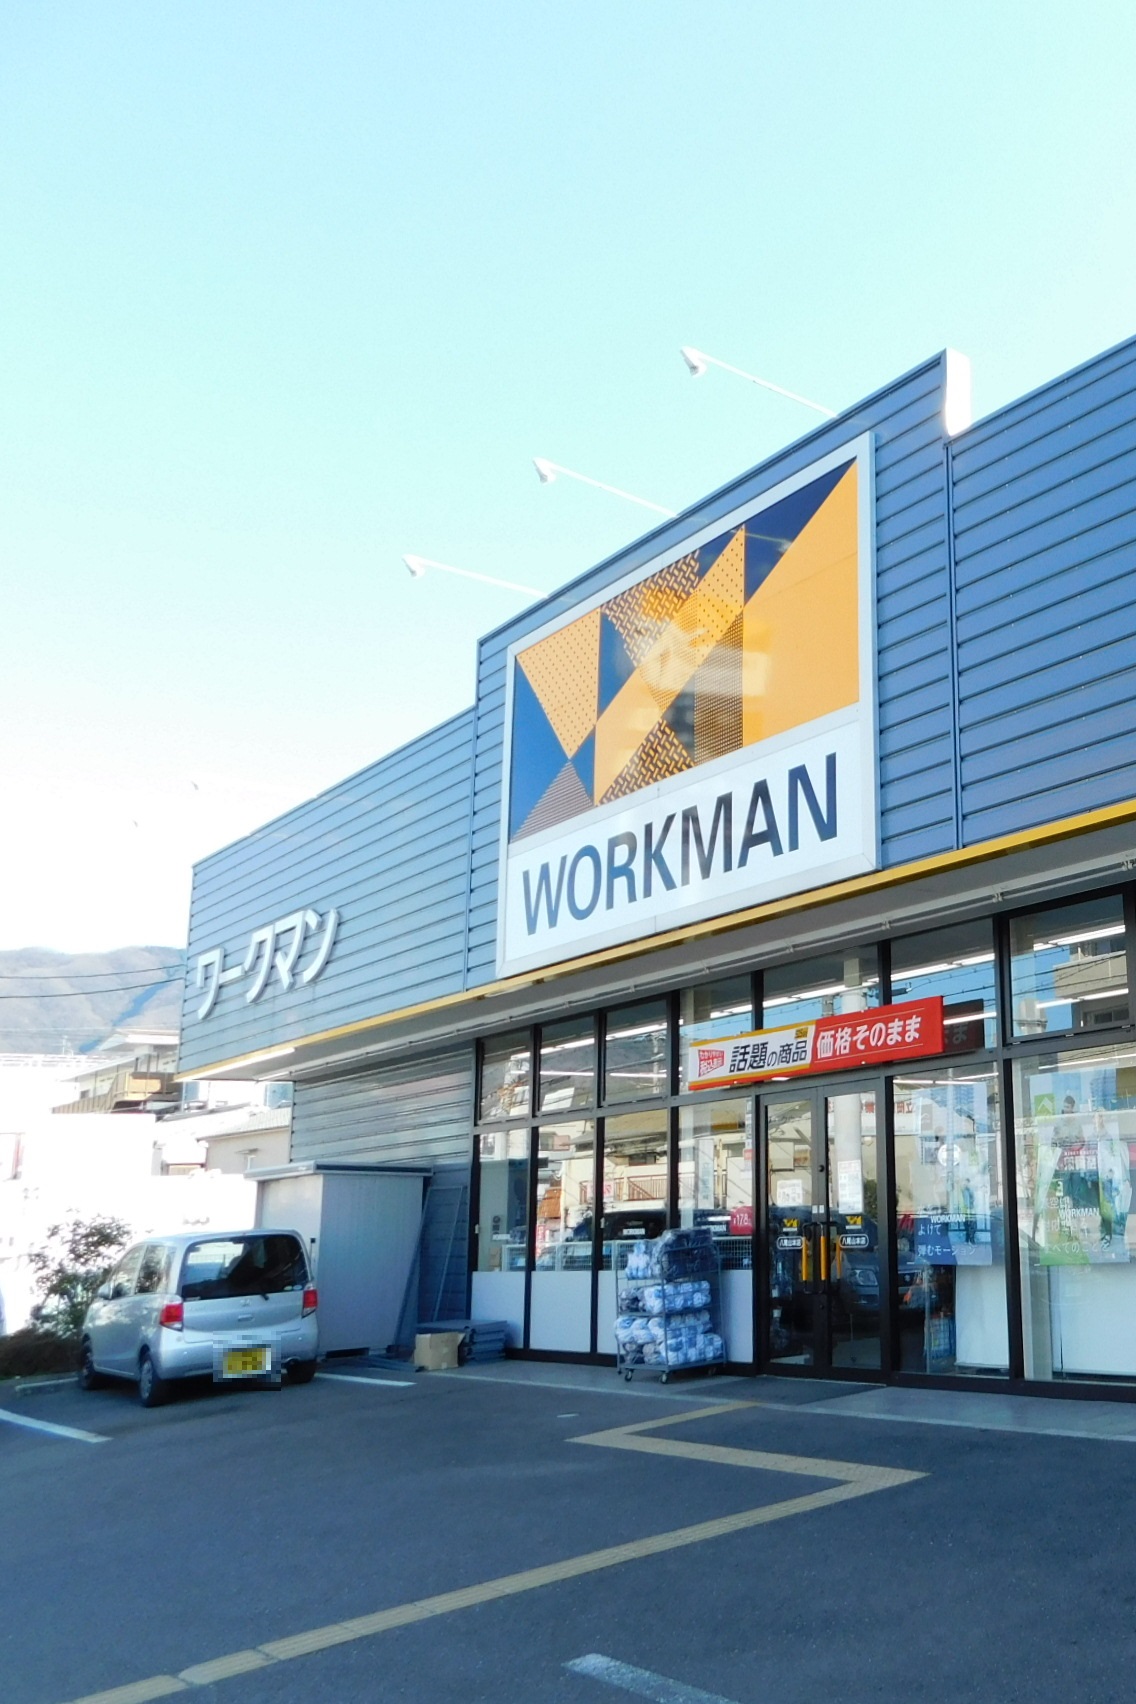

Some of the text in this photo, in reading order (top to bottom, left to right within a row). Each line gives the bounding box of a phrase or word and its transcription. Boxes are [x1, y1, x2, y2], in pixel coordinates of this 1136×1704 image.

[522, 751, 838, 935] WORKMAN
[196, 908, 339, 1020] ワークマン
[729, 1039, 808, 1074] 話題の商品
[816, 1015, 922, 1060] 価格そのまま
[917, 1223, 942, 1236] よけて
[930, 1214, 966, 1224] WORKMAN
